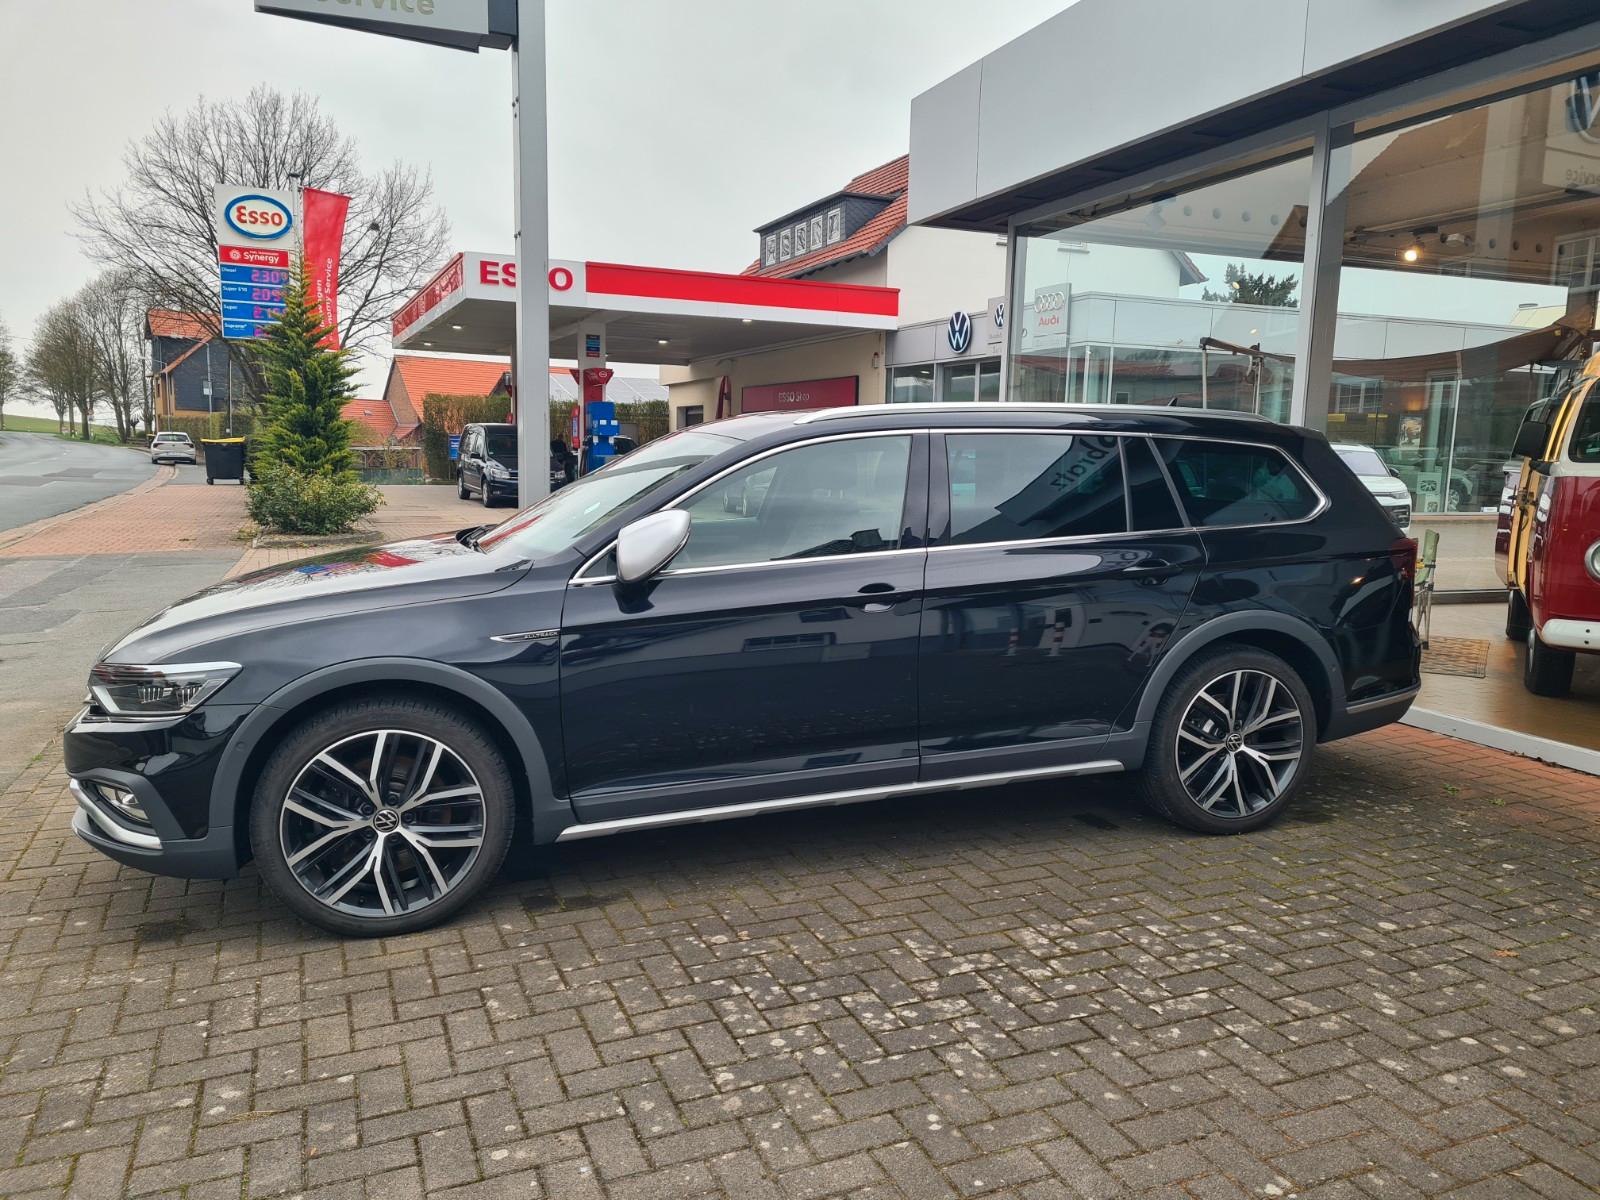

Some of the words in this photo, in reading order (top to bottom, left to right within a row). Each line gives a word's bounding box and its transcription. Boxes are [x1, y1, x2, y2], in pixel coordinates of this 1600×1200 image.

[236, 205, 283, 226] Esso
[242, 251, 279, 263] Synergy
[324, 257, 333, 293] Service
[479, 260, 574, 292] ESO
[1038, 315, 1060, 326] Audi
